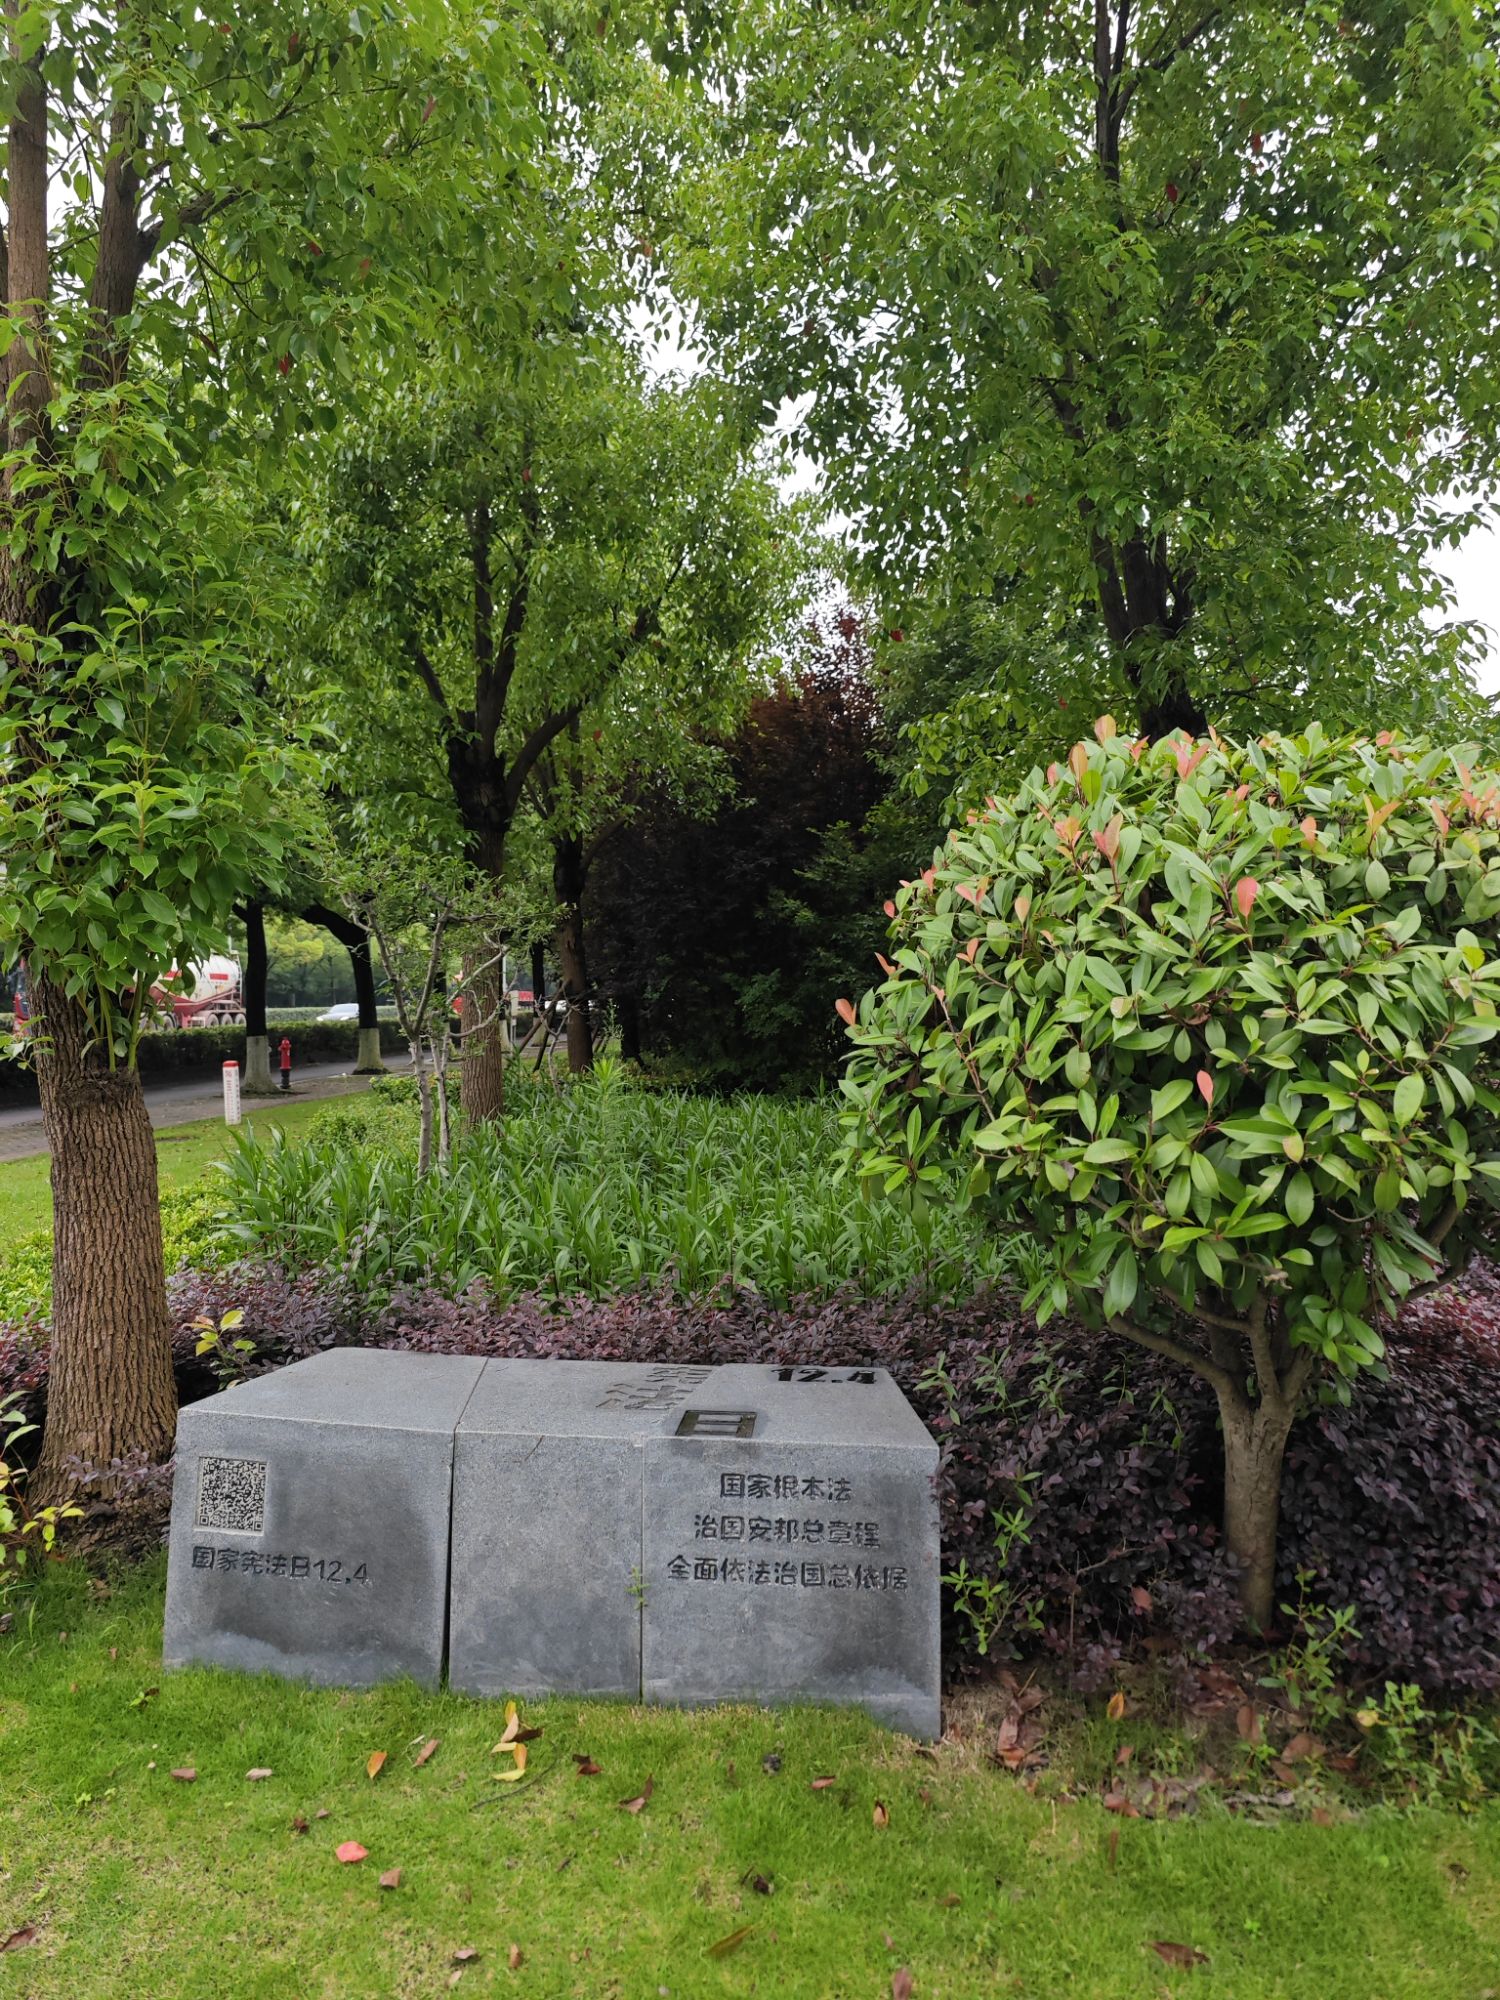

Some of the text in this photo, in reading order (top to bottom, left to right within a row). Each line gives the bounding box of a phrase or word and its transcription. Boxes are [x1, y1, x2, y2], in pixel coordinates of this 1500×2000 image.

[771, 1368, 877, 1384] 12.4
[720, 1473, 852, 1501] 国家根本法
[694, 1513, 881, 1549] 治国安邦总章程
[667, 1554, 908, 1590] 全面依法治国总依据
